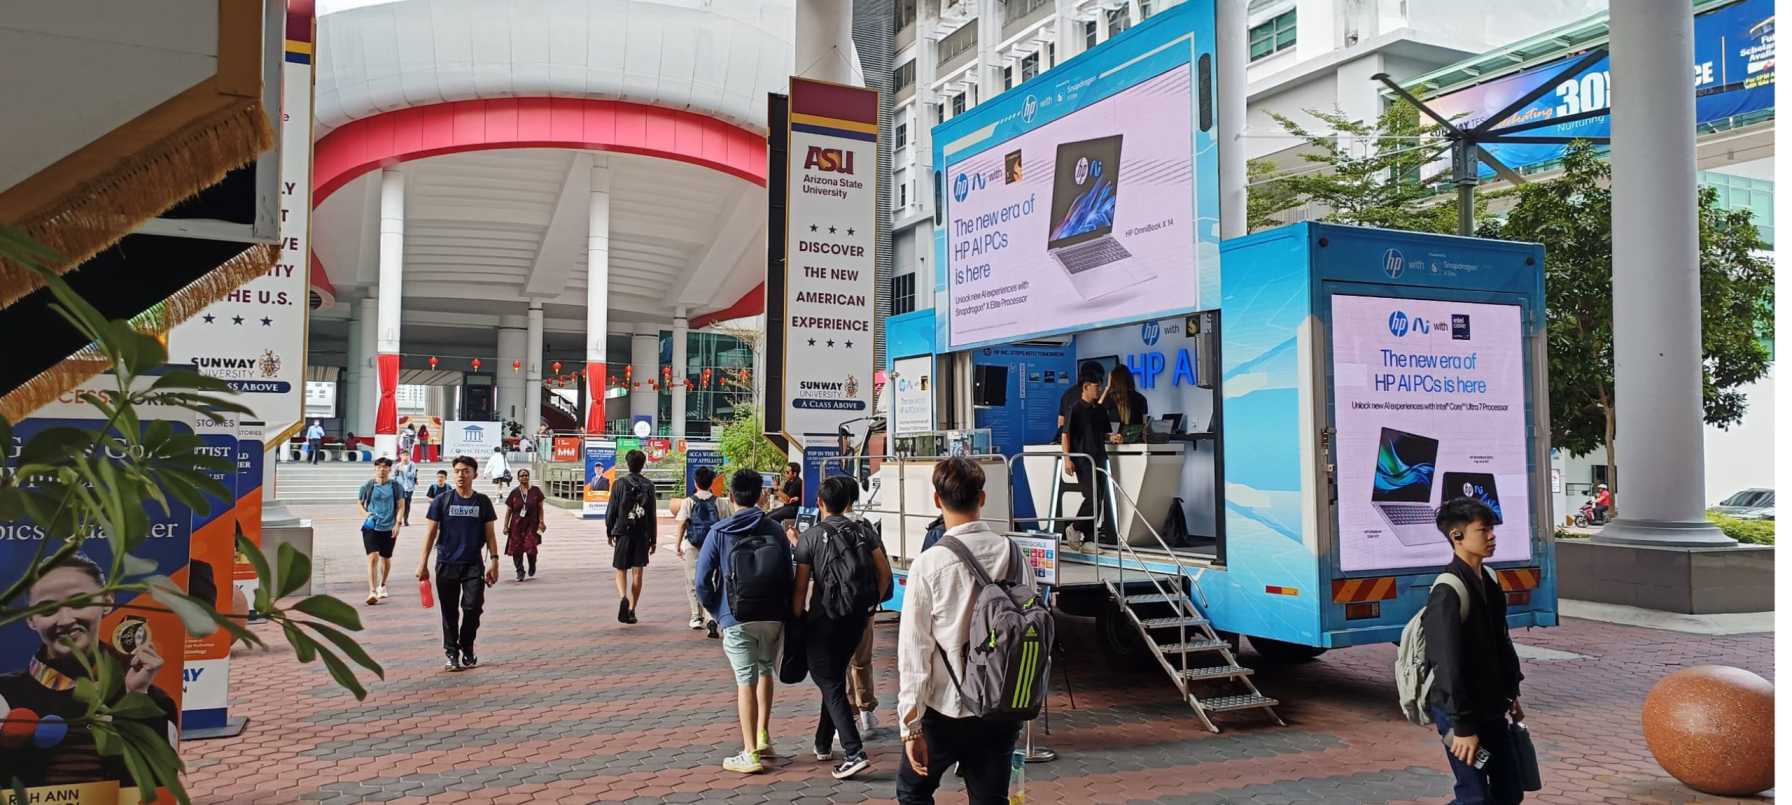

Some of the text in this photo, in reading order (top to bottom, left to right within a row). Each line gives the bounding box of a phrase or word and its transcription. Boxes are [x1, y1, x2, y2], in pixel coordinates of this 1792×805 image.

[804, 145, 854, 175] ASU
[803, 174, 863, 189] Arizona State
[954, 173, 968, 202] hp
[803, 185, 848, 199] University
[954, 193, 1036, 237] The new era of
[799, 241, 864, 257] DISCOVER
[955, 231, 1008, 262] HP AI PCs
[1383, 248, 1405, 279] hp
[804, 266, 859, 281] THE NEW
[955, 263, 991, 286] is here
[228, 289, 293, 305] HE U.S.
[796, 291, 865, 307] AMERICAN
[792, 316, 869, 332] EXPERIENCE
[1389, 310, 1408, 337] hp
[1434, 321, 1449, 332] with
[1142, 319, 1179, 346] hp with
[191, 357, 256, 369] SUNWAY
[1381, 349, 1477, 370] The new era of
[1127, 352, 1165, 388] HP
[242, 383, 279, 392] ABOVE
[800, 381, 843, 391] SUNWAY
[1375, 374, 1486, 393] HP AI PCs is here
[800, 391, 842, 399] UNIVERSITY
[810, 401, 832, 409] CLASS
[1352, 401, 1370, 410] Unlock
[1390, 402, 1423, 412] experiences
[1423, 401, 1435, 411] with
[1482, 402, 1509, 412] Processor
[45, 788, 80, 801] ANN
